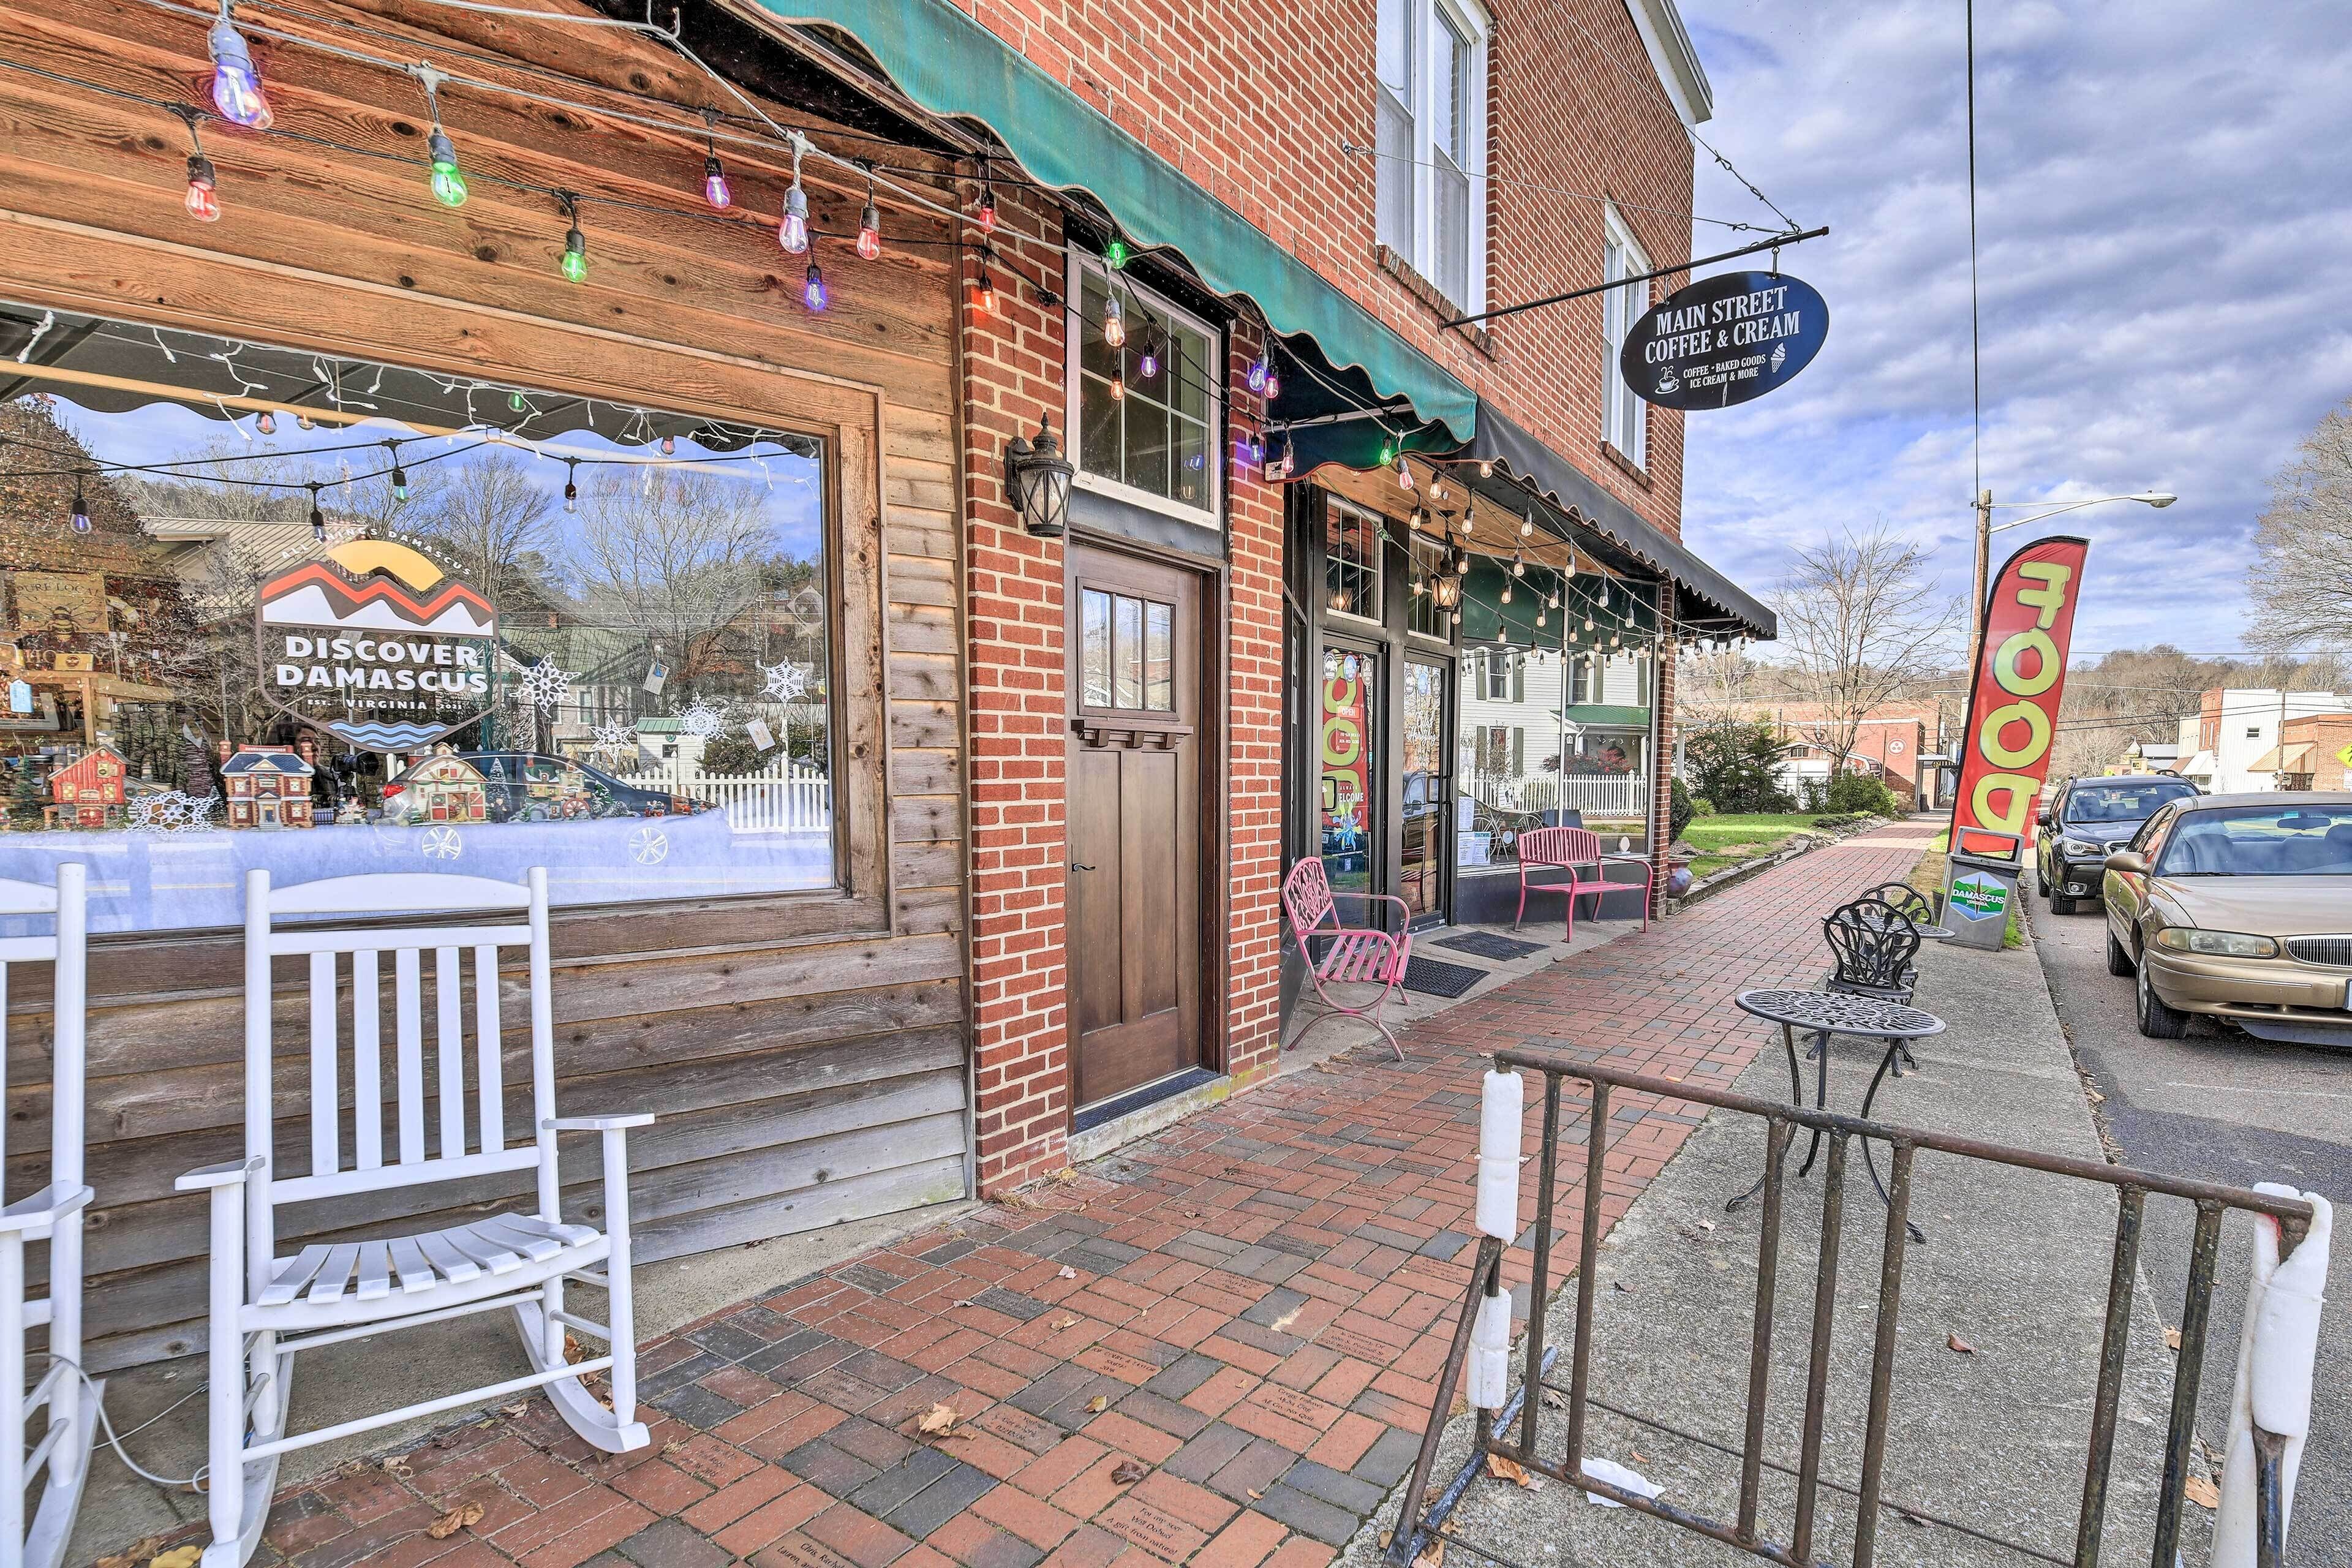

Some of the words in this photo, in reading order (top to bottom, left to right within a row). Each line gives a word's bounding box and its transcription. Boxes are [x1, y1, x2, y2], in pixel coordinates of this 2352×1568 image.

[1656, 303, 1706, 336] MAIN
[1712, 285, 1788, 325] STREET
[1645, 329, 1712, 364] COFFEE
[1717, 330, 1728, 348] &
[1733, 311, 1800, 346] CREAM
[1683, 364, 1709, 379] COFFEE
[1715, 359, 1740, 373] BAKED
[1741, 353, 1766, 368] GOODS
[1690, 378, 1702, 389] ICE
[1702, 372, 1727, 386] CREAM
[1729, 371, 1736, 381] &
[1737, 367, 1759, 380] MORE
[282, 543, 310, 559] ALL
[314, 528, 379, 545] THINGS
[388, 530, 472, 576] DAMASCUS
[17, 582, 51, 595] PURE
[56, 583, 99, 597] LOCAL
[285, 636, 484, 666] DISCOVER
[276, 664, 488, 693] DAMASCUS
[345, 699, 428, 710] VIRGINIA
[1341, 707, 1355, 716] OPEN
[1952, 889, 2005, 904] DAMASCUS
[1131, 1528, 1149, 1541] from
